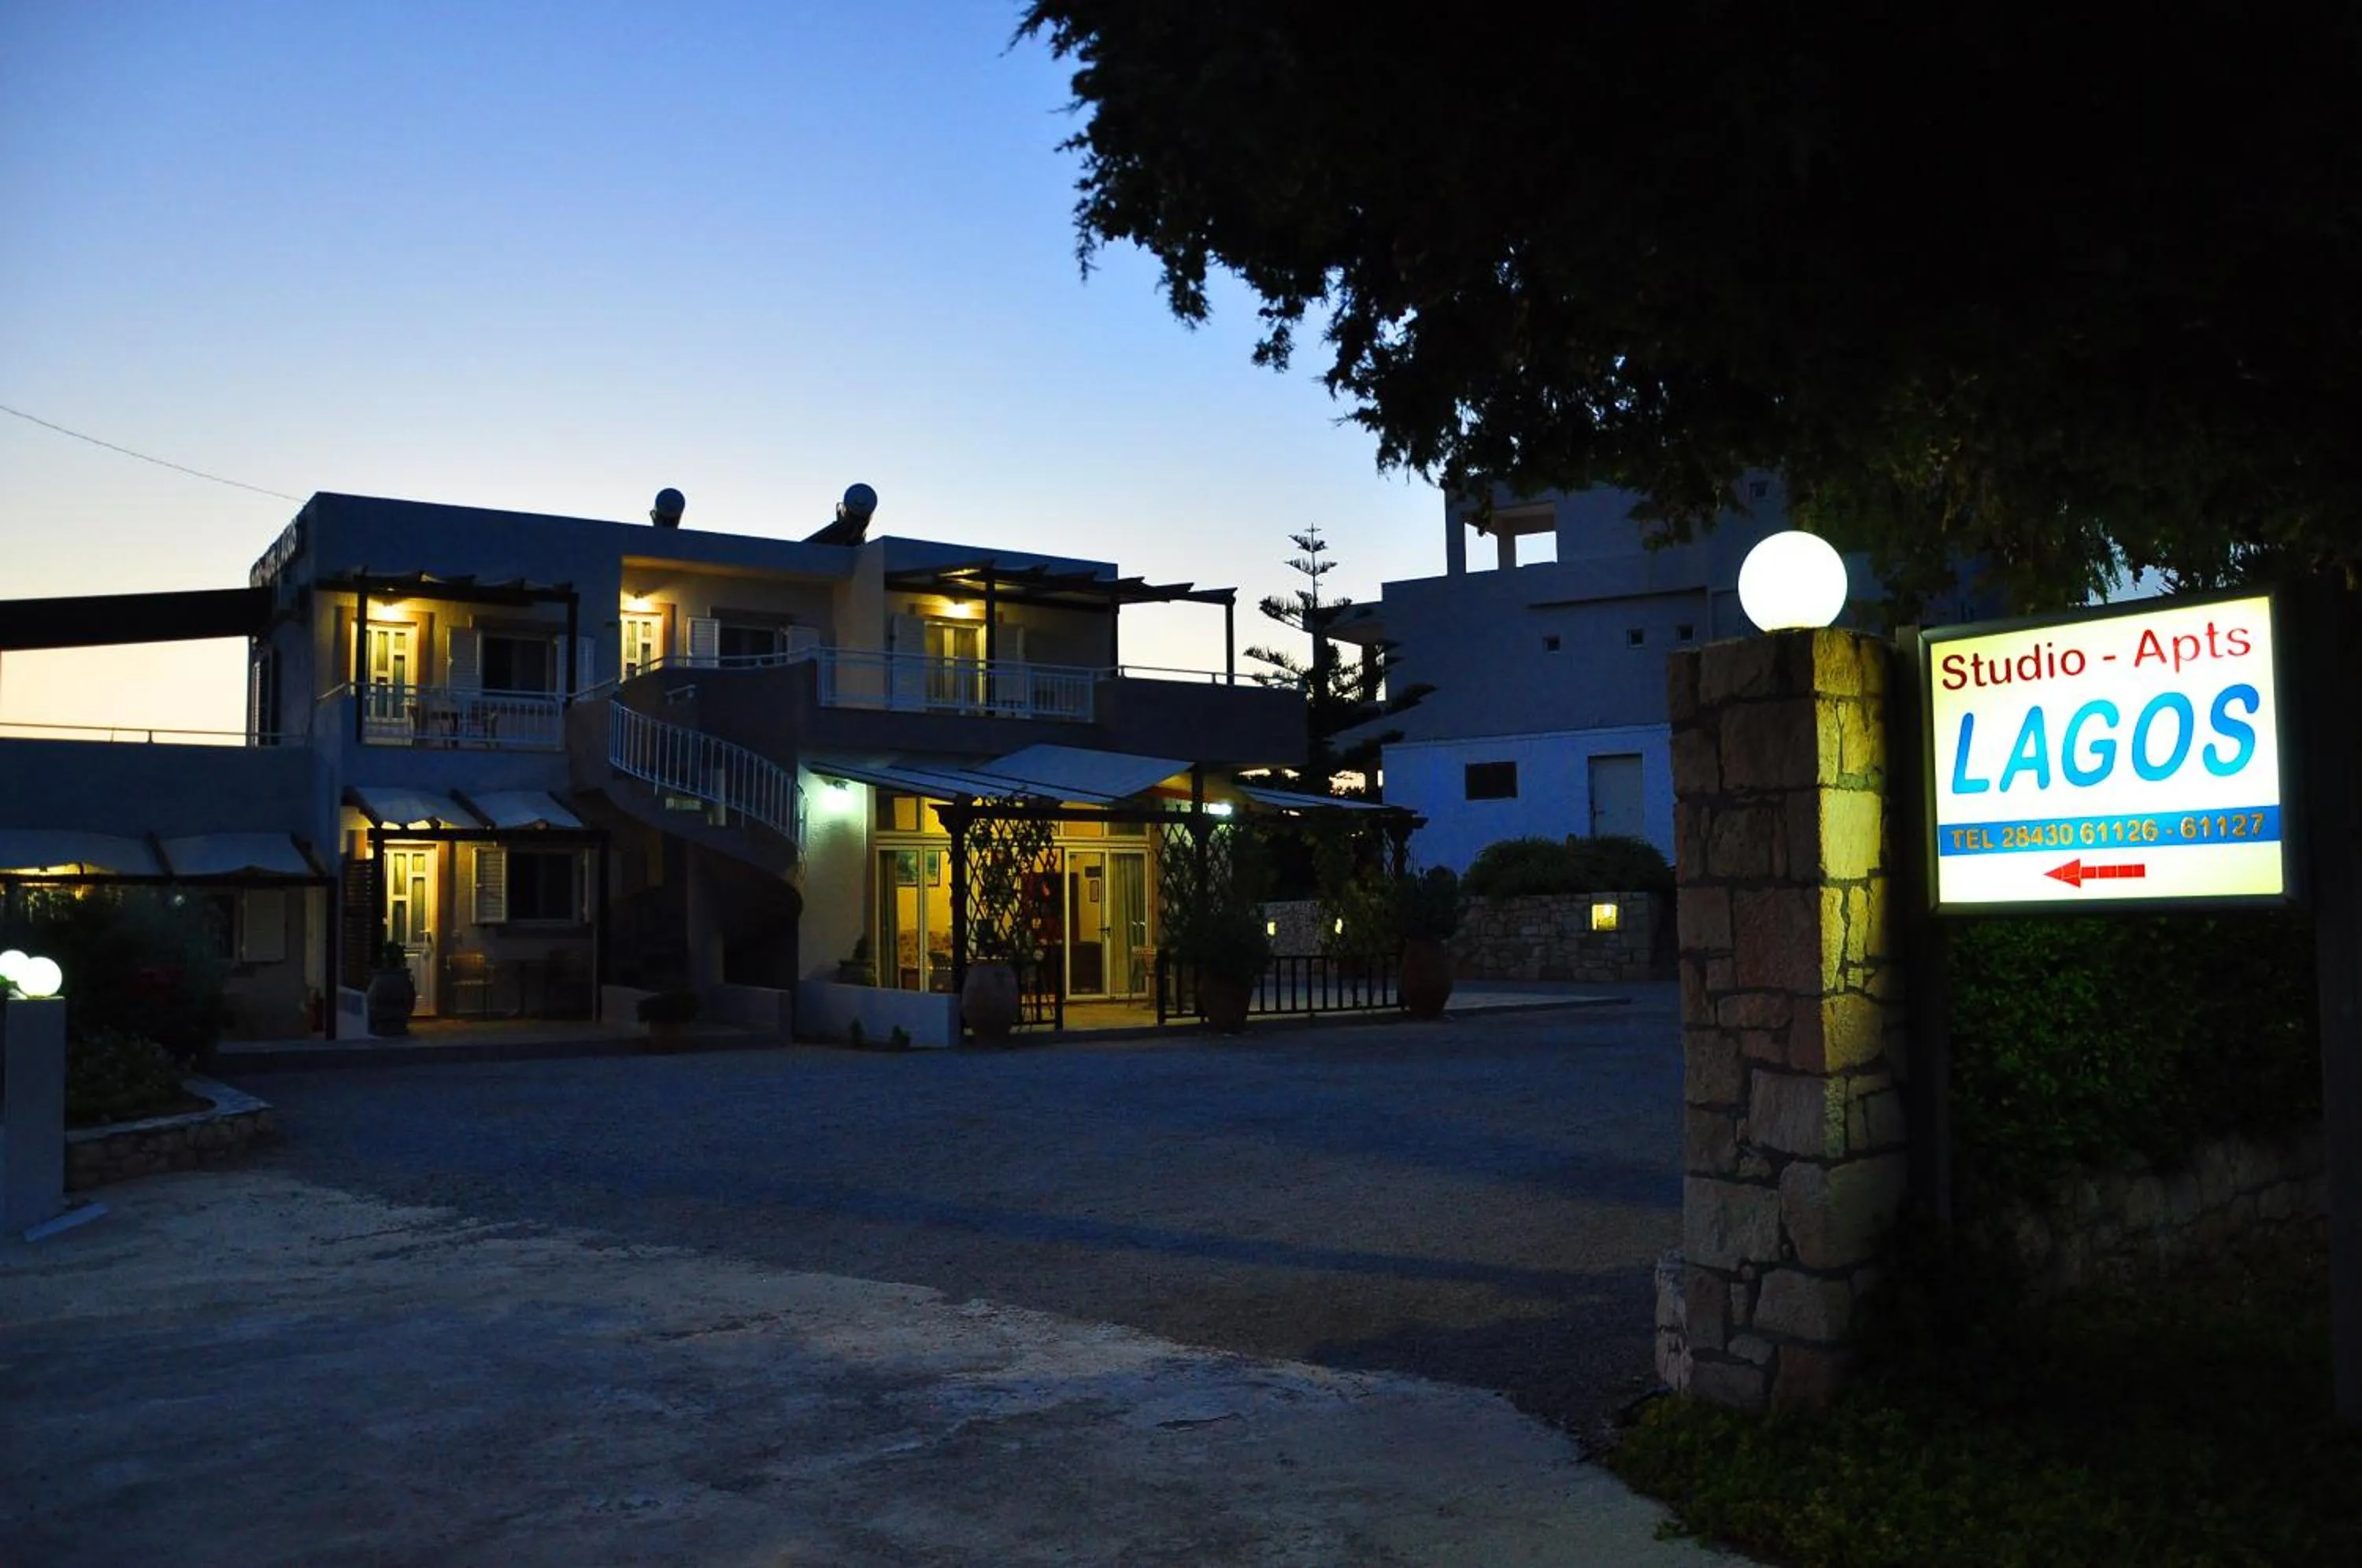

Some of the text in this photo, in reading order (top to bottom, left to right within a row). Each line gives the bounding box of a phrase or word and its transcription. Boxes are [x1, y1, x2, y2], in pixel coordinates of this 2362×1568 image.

[1942, 642, 2086, 690] Studio
[2134, 621, 2251, 673] Apts
[1952, 683, 2260, 794] LAGOS
[1951, 828, 1994, 849] TEL
[2002, 823, 2074, 848] 28430
[2079, 819, 2159, 844] 61126
[2180, 813, 2264, 839] 61127
